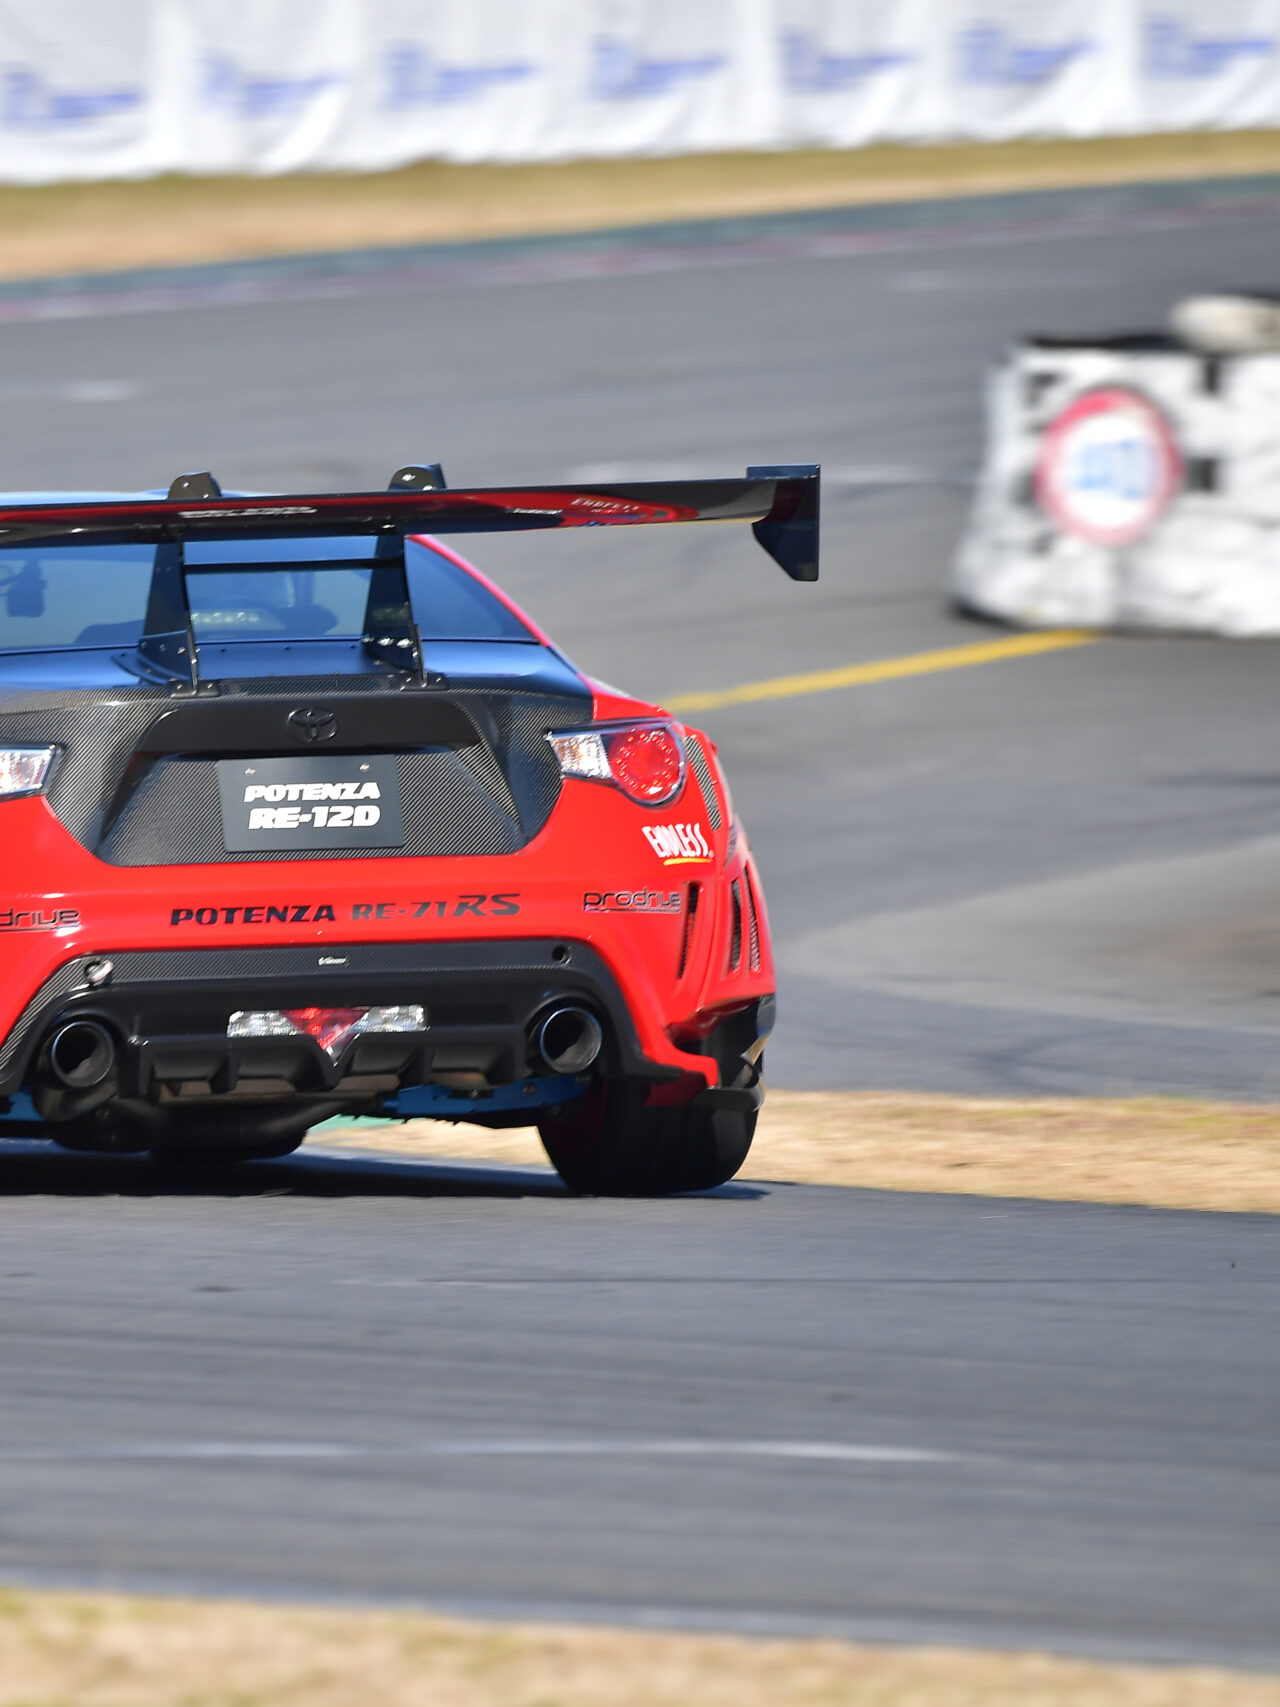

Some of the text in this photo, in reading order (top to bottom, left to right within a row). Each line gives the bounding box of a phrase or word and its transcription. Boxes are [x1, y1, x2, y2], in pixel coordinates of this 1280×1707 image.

[244, 782, 381, 803] POTENZA
[248, 805, 381, 830] RE-12D
[640, 822, 710, 858] ENDLESS
[170, 904, 337, 926] POTENZA
